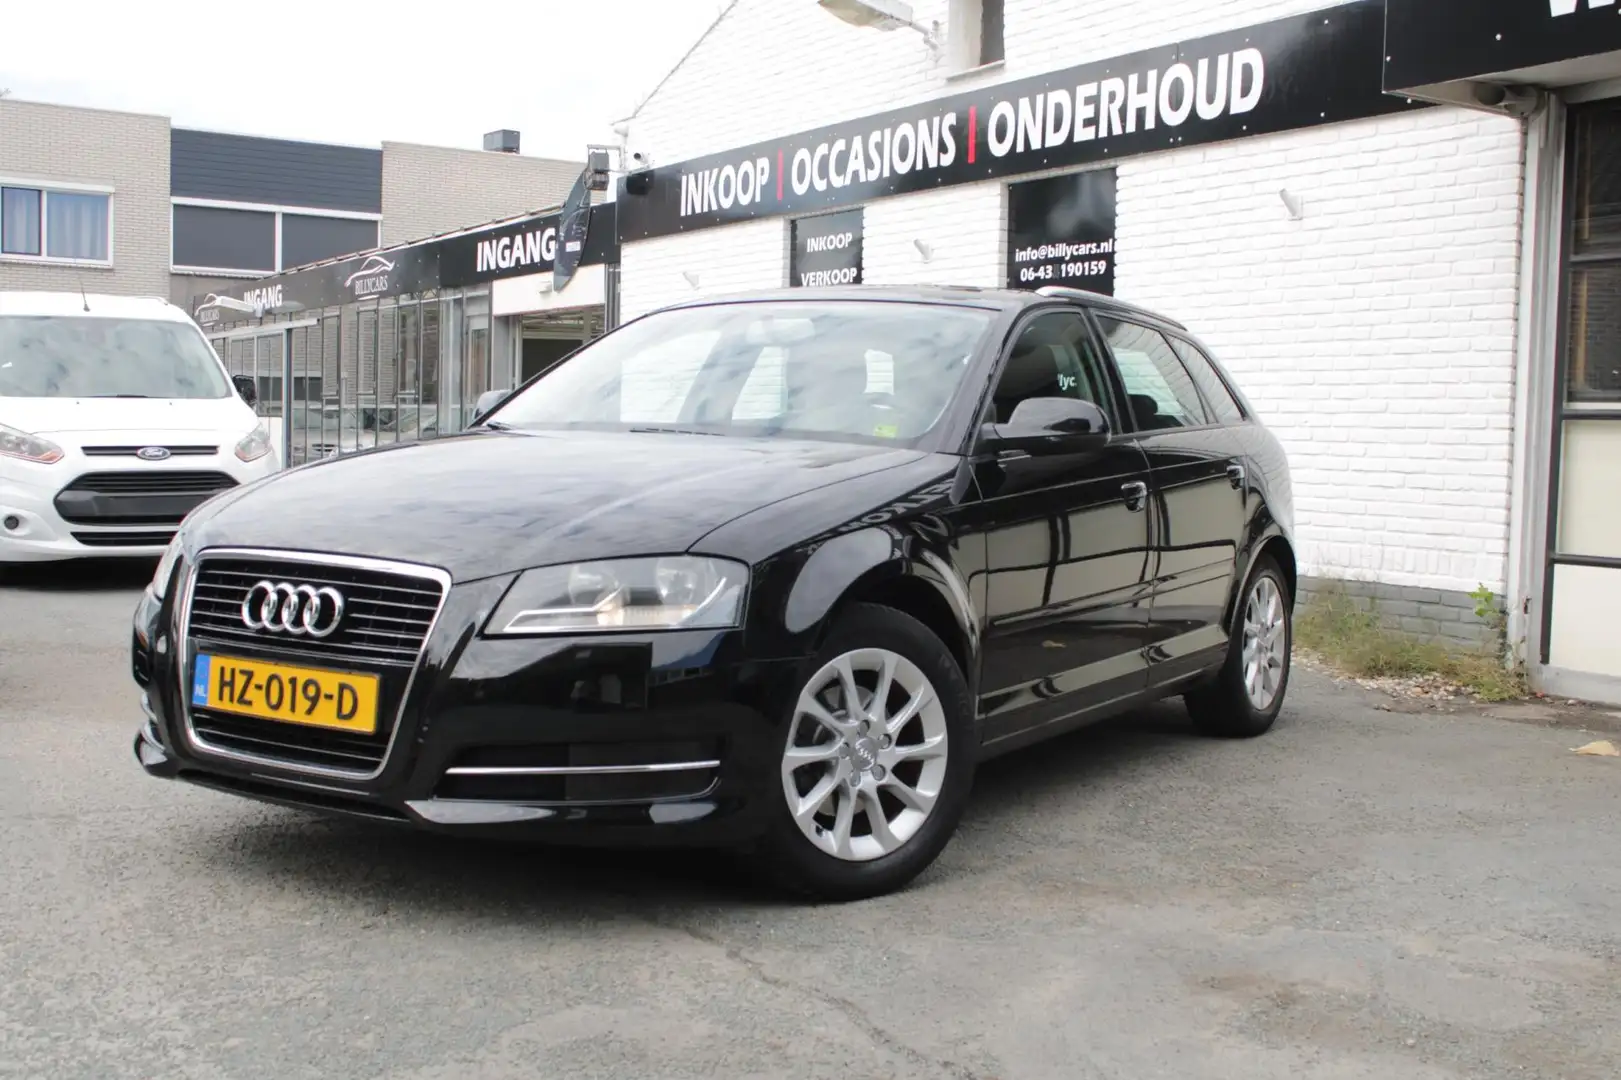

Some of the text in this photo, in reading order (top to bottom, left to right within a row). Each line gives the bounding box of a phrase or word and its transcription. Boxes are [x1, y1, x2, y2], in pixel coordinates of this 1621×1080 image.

[679, 47, 1265, 218] INKOOP OCCASIONS ONDERHOUD
[476, 227, 556, 272] INGANG
[806, 232, 853, 253] INKOOP
[1015, 238, 1113, 262] info@billycars.nl
[800, 267, 858, 287] VERKOOP
[1020, 260, 1107, 282] 06-43 190159
[355, 275, 388, 295] BILLYCARS
[218, 665, 359, 721] HZ-019-D
